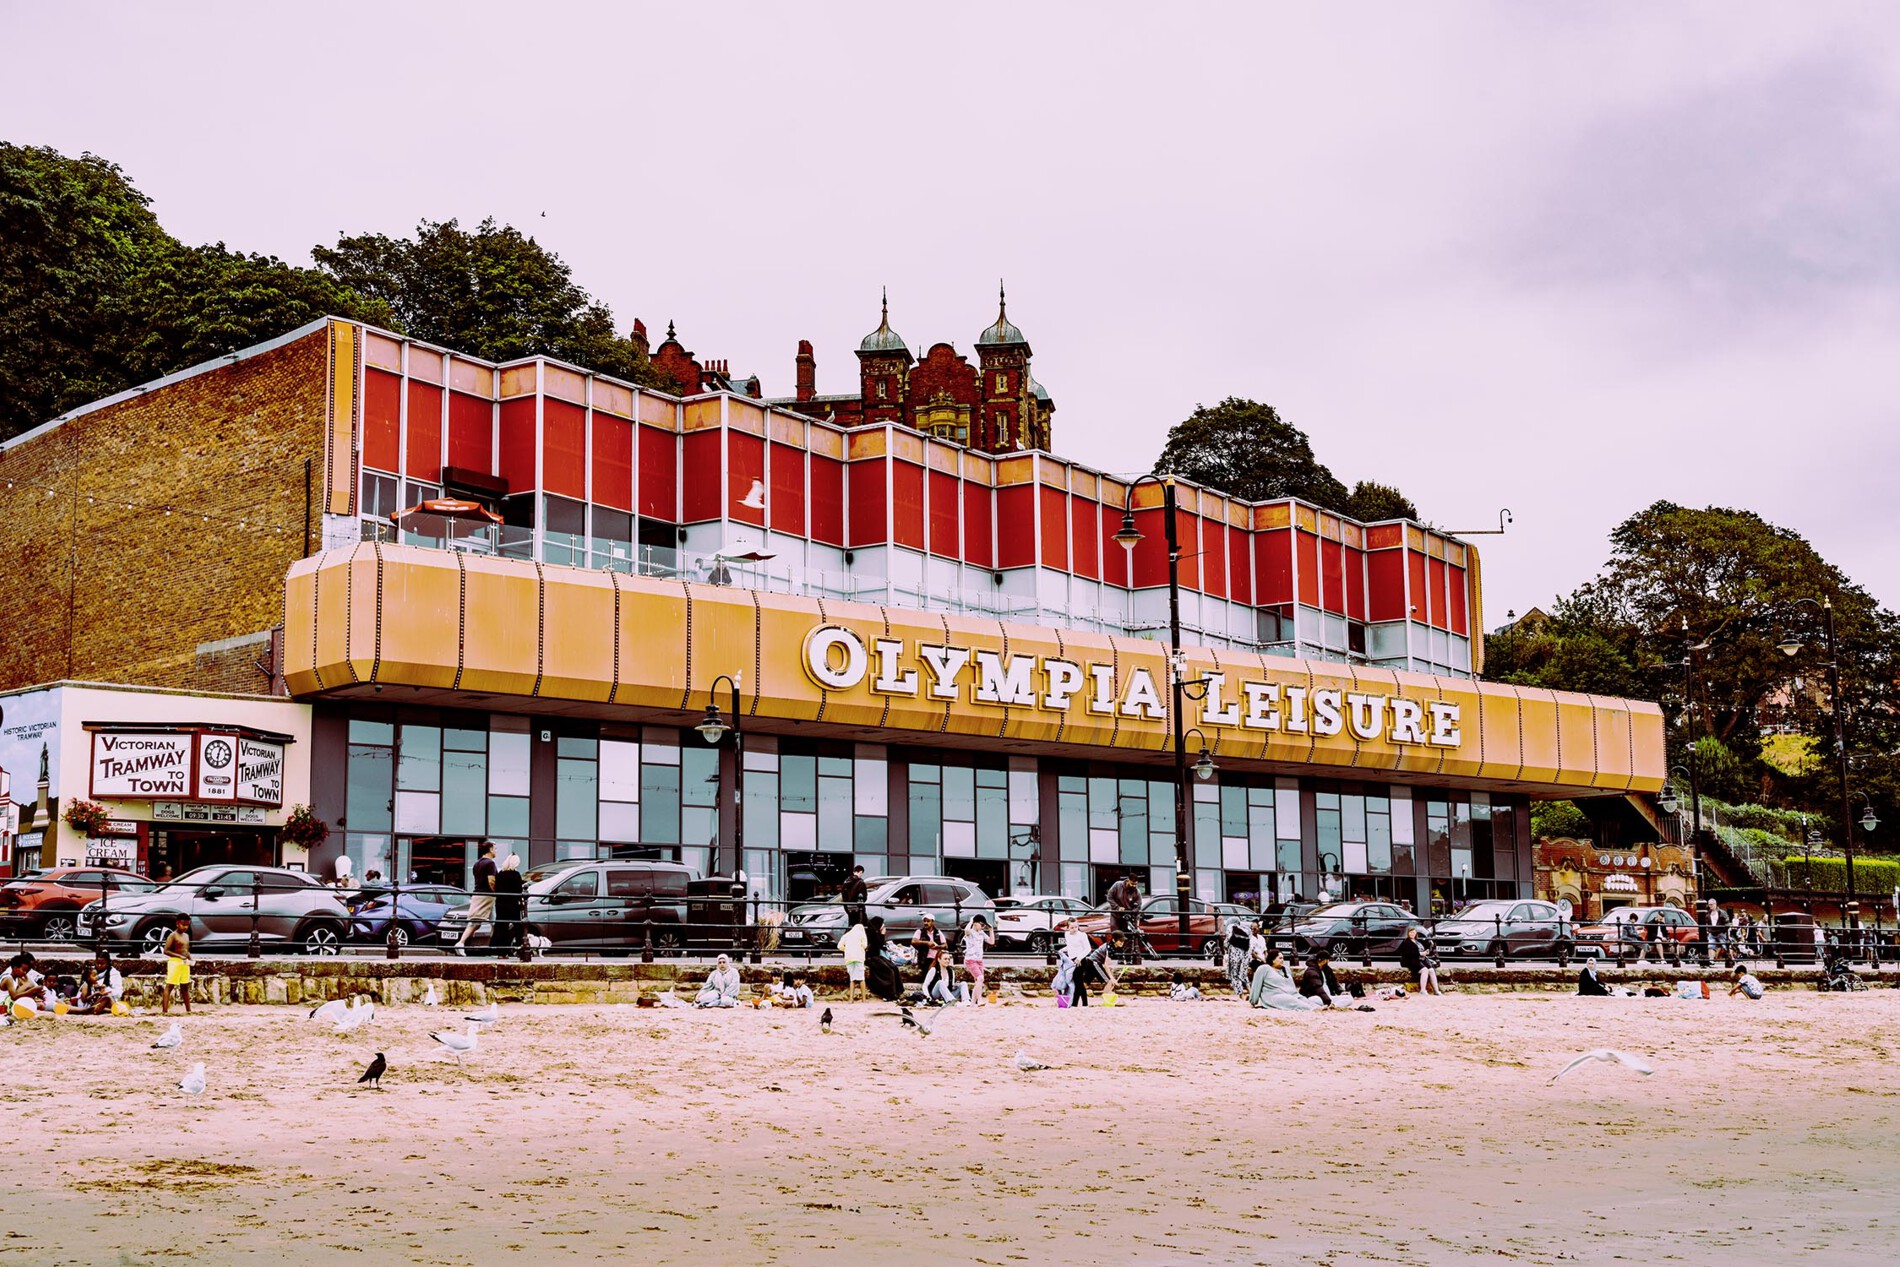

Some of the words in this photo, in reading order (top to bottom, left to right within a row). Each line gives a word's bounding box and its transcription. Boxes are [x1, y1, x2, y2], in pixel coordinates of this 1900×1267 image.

[805, 625, 1167, 721] OLYMPIA
[1198, 669, 1462, 748] LEISURE
[3, 725, 28, 736] HISTORIC
[28, 720, 57, 732] VICTORIAN
[17, 730, 43, 741] TRAMWAY
[99, 749, 186, 778] TRAMWAY
[168, 771, 185, 780] TO
[238, 760, 281, 782] TRAMWAY
[128, 778, 184, 792] TOWN
[270, 779, 280, 788] TO
[207, 787, 226, 795] 1881
[251, 783, 280, 801] TOWN
[100, 838, 117, 848] ICE
[88, 848, 127, 858] CREAM
